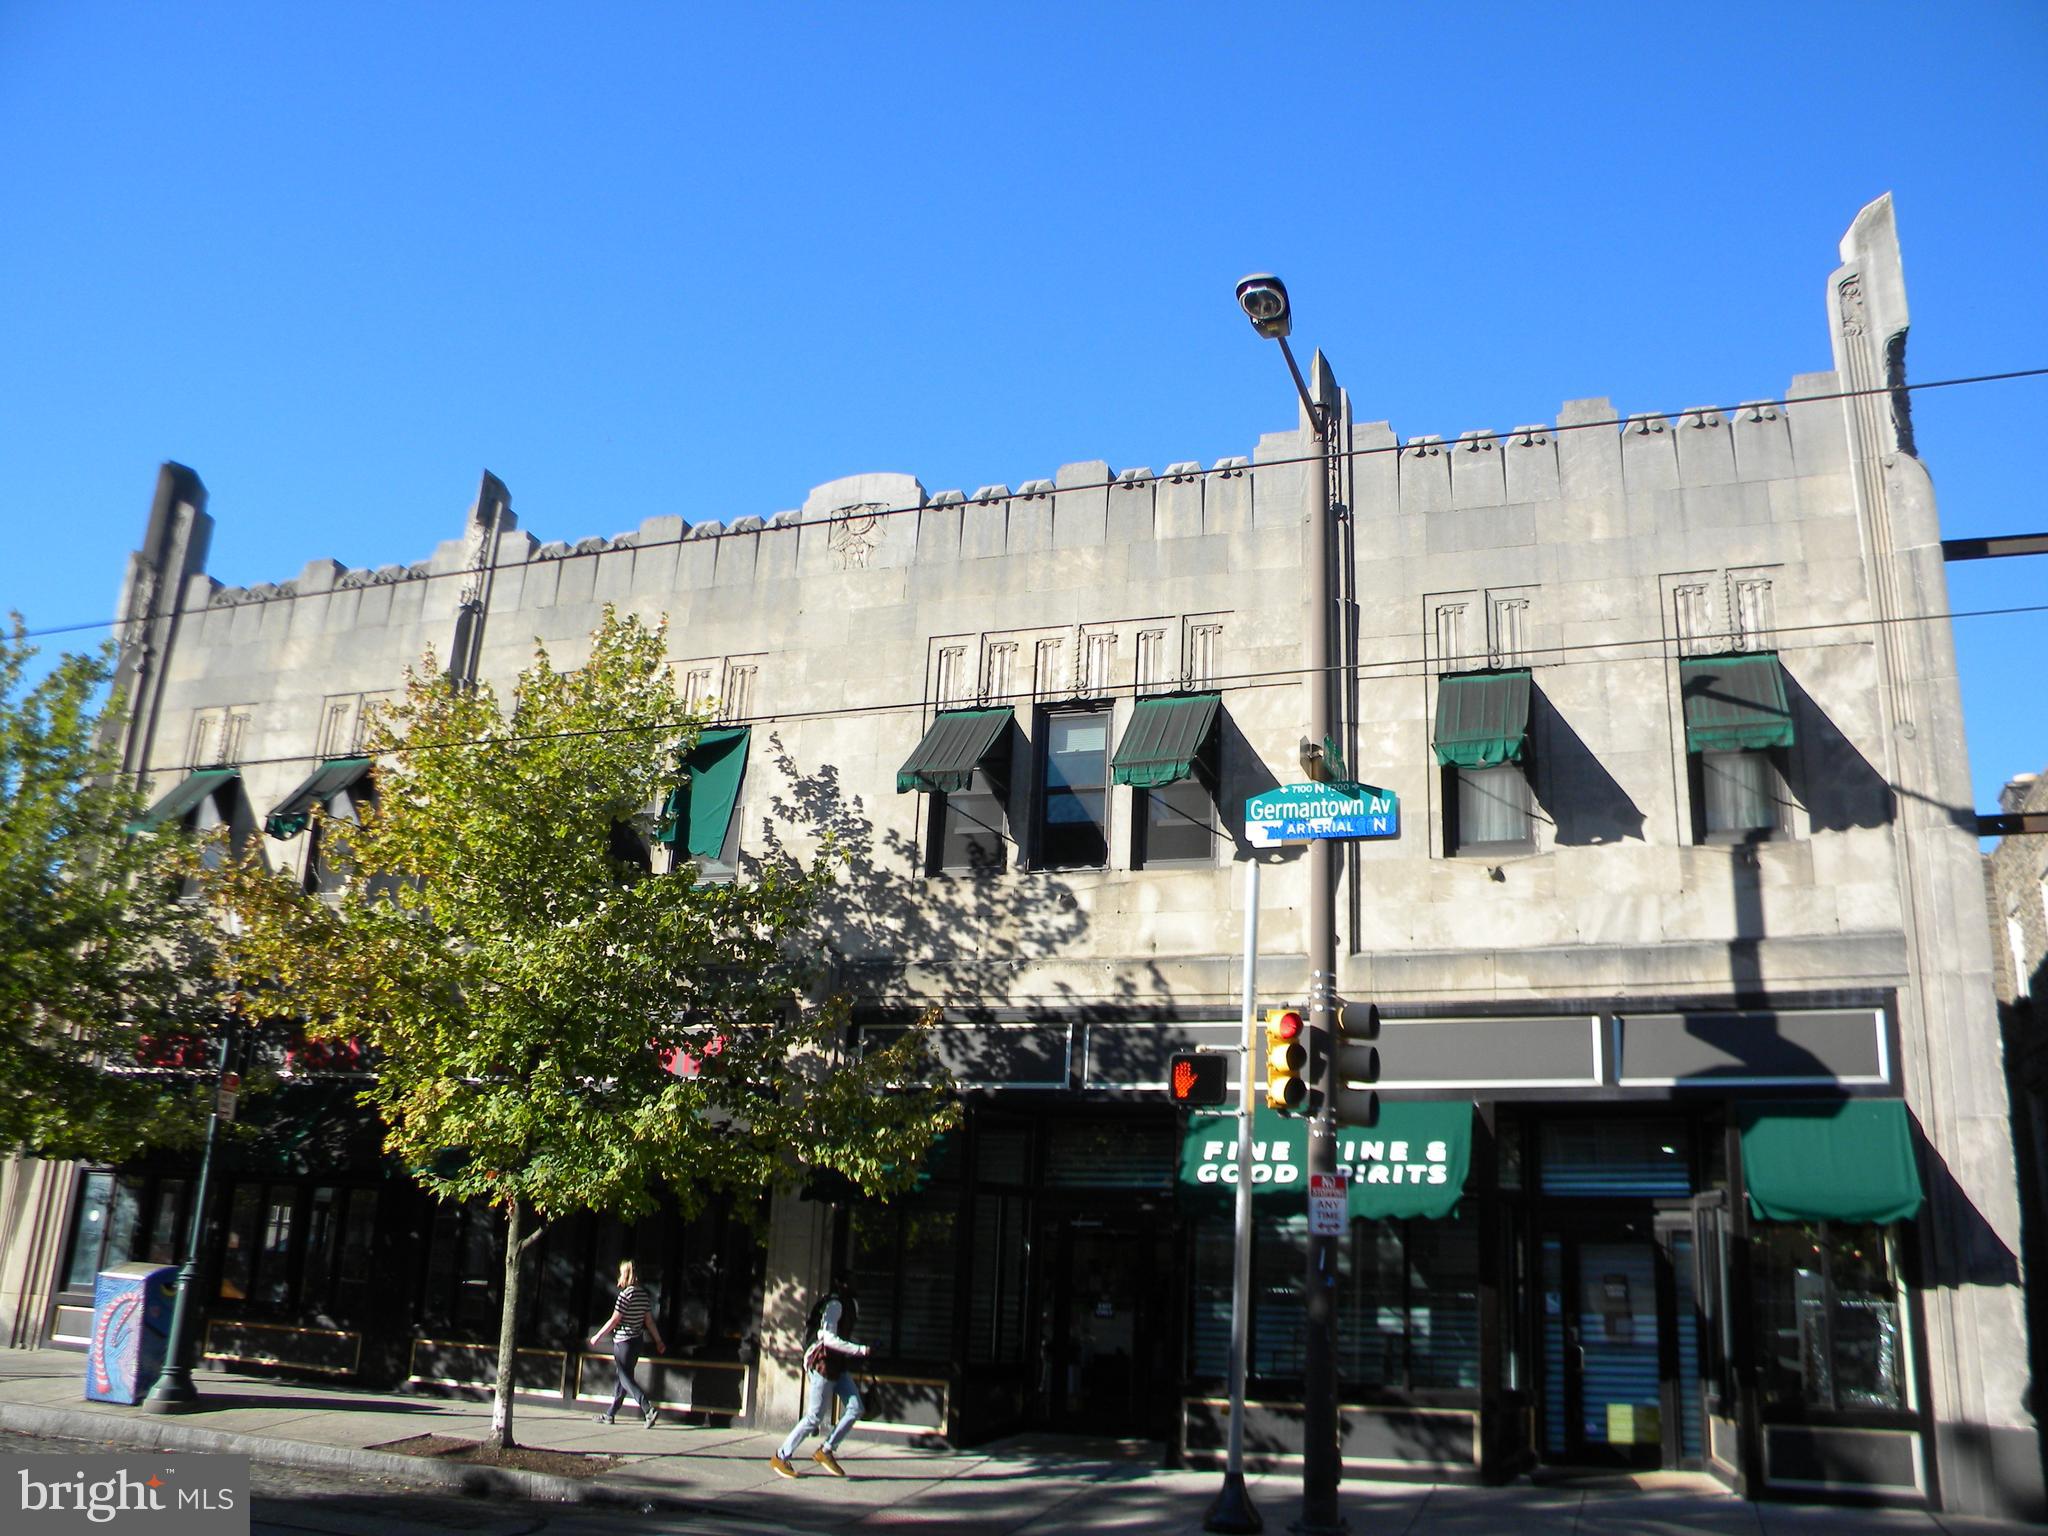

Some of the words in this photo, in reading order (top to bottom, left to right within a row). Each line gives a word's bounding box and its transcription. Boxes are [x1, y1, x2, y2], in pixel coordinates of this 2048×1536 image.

[1291, 785, 1312, 794] 7100
[1314, 783, 1325, 793] N
[1250, 798, 1364, 820] Germantown
[1369, 797, 1391, 814] Av
[1286, 822, 1355, 835] ARTERIAL
[1373, 817, 1387, 832] N
[1203, 1141, 1291, 1161] FINE
[1336, 1141, 1409, 1161] INE
[1425, 1141, 1447, 1162] &
[1197, 1163, 1299, 1184] GOOD
[1336, 1164, 1447, 1185] PIRITS
[1321, 1175, 1336, 1188] NO
[1318, 1200, 1340, 1209] ANY
[1317, 1211, 1340, 1220] TIME
